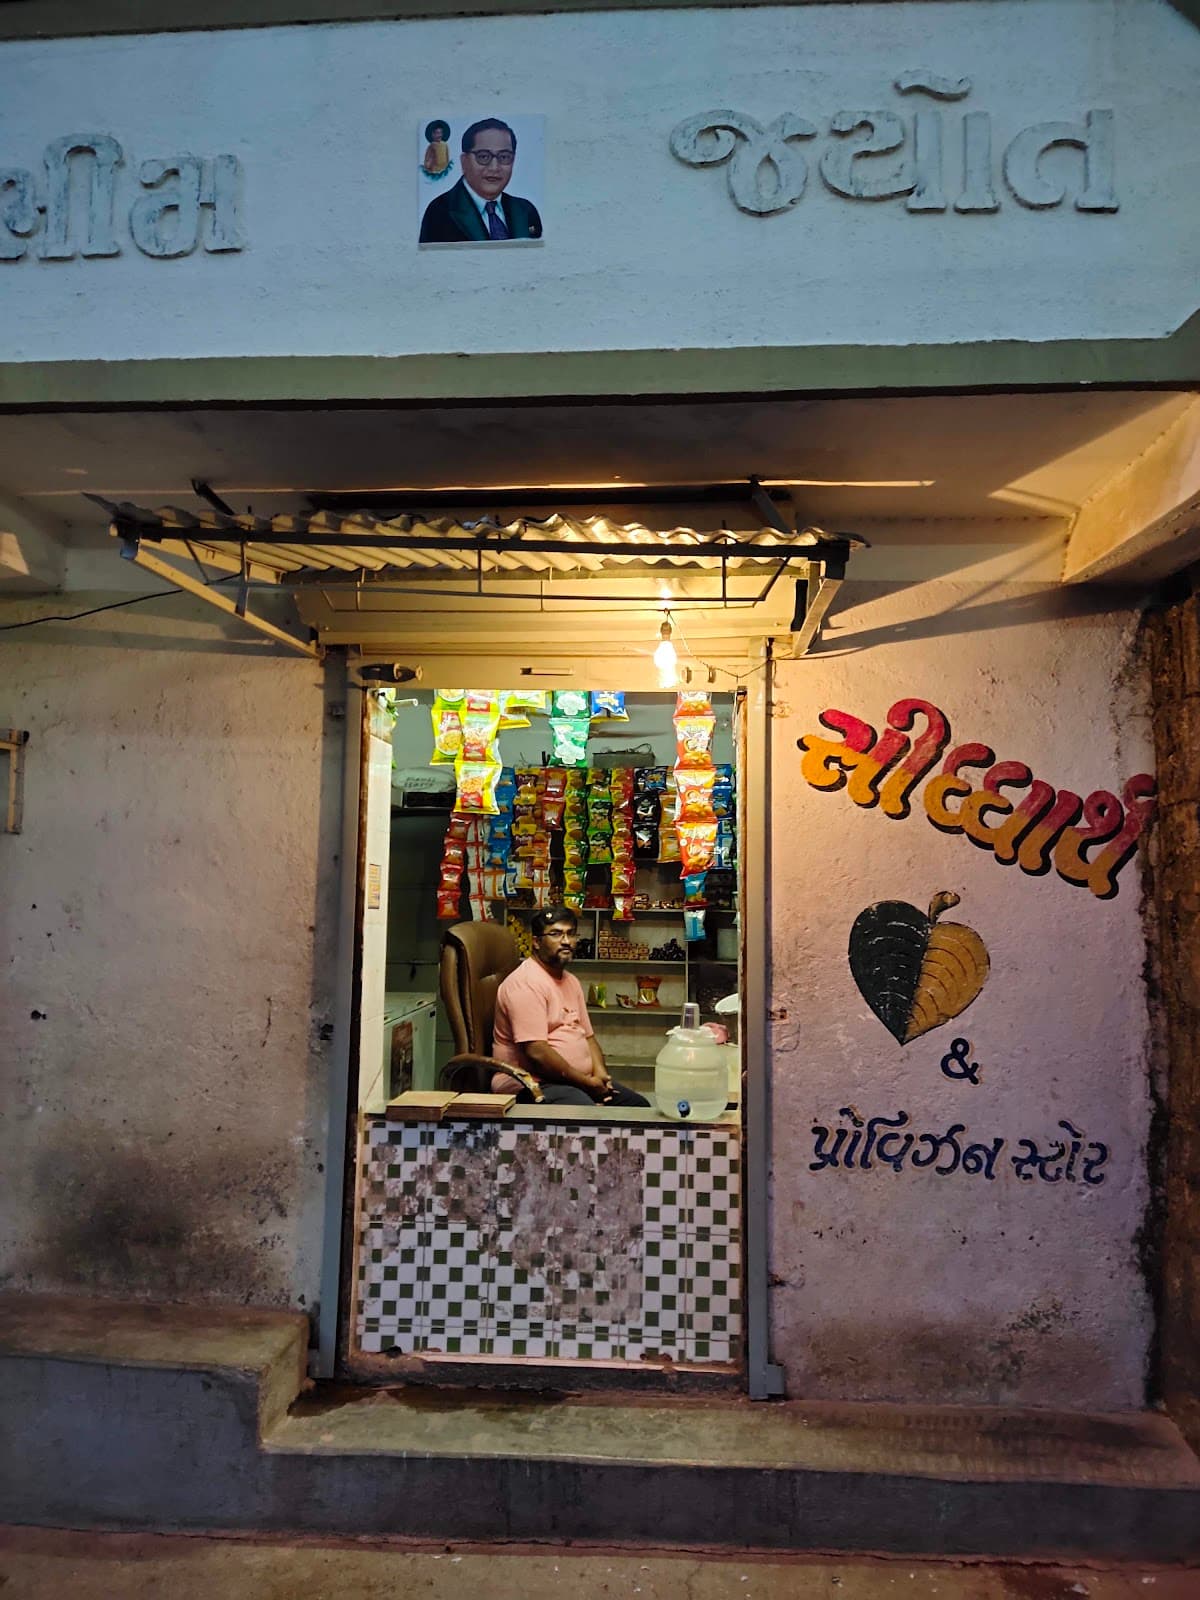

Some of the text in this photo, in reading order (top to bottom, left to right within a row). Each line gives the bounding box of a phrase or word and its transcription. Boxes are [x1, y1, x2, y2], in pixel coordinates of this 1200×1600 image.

[940, 1037, 980, 1085] &
[809, 1107, 1109, 1185] પ્રોવિઝન સ્ટોર
